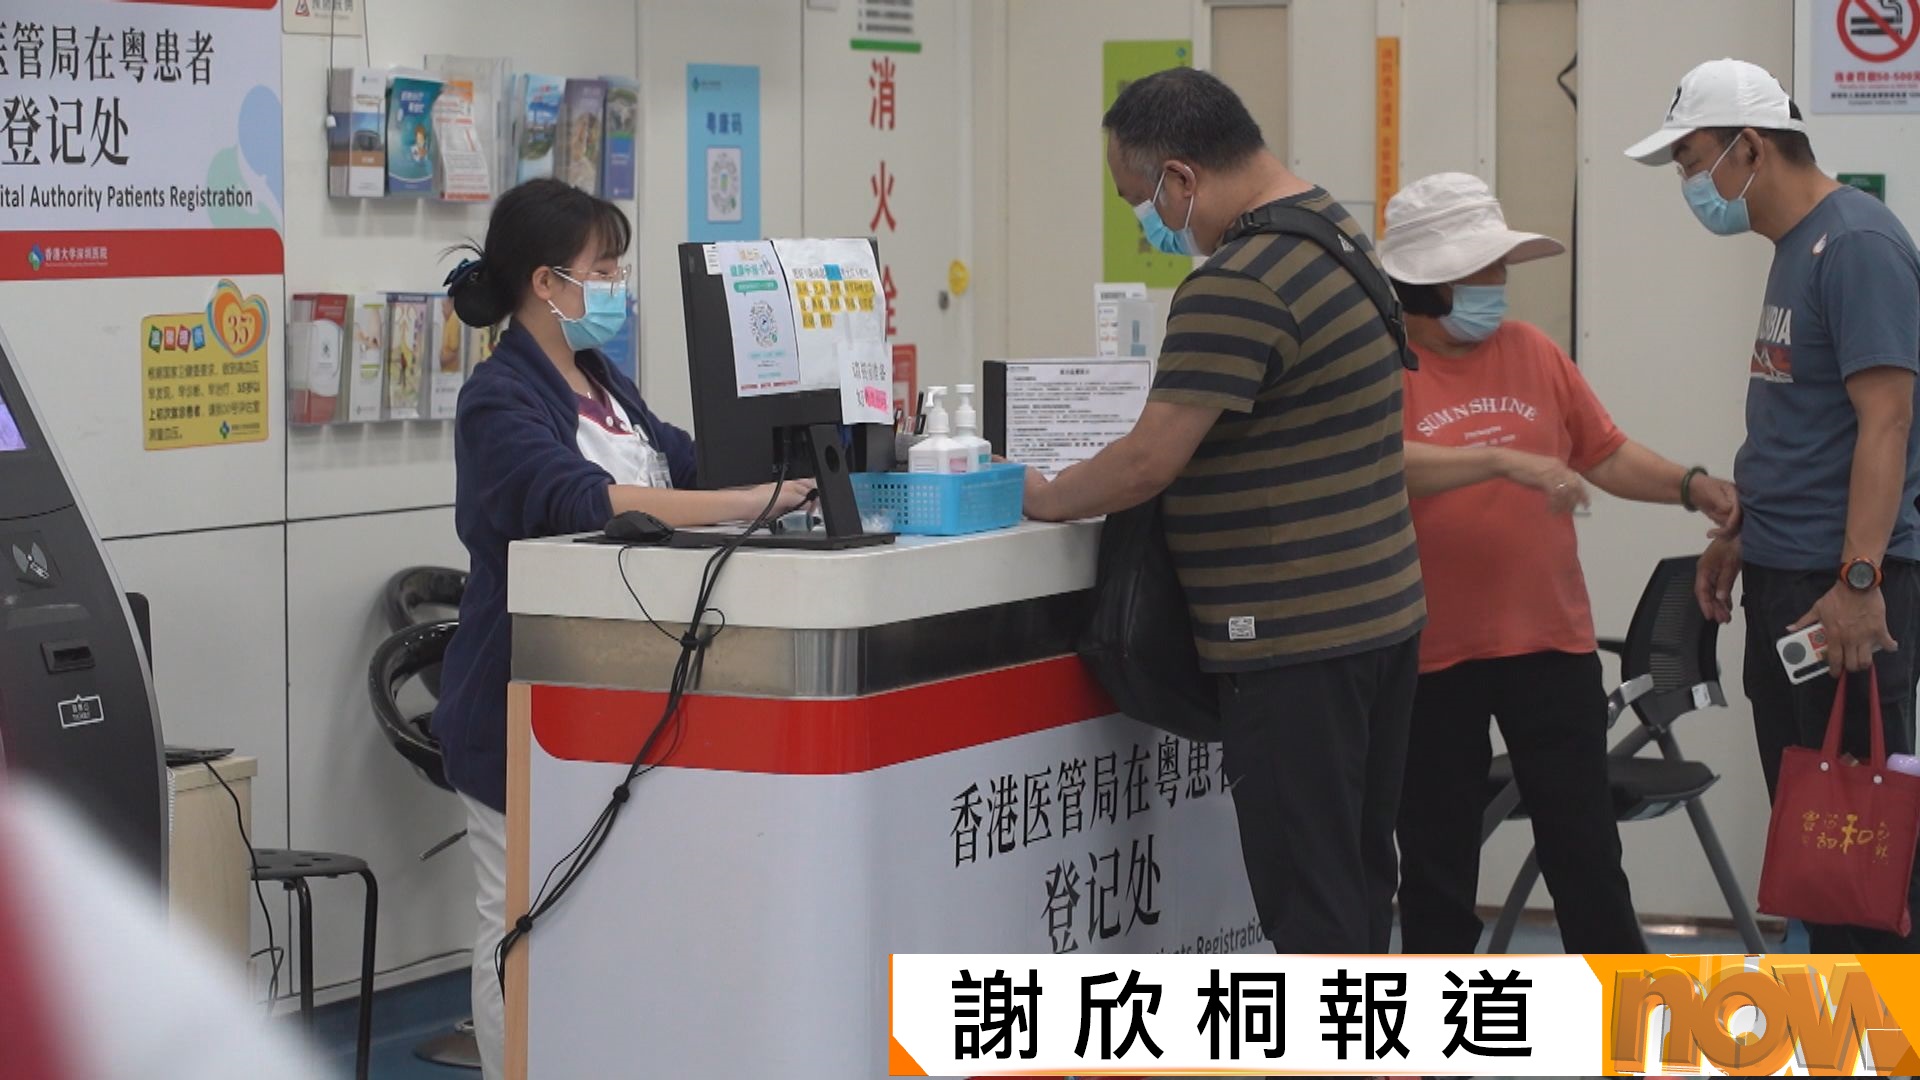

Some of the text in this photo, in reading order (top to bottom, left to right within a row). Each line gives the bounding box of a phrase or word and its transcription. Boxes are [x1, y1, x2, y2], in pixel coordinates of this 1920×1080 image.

[0, 20, 214, 86] 管局在粤患者
[0, 94, 130, 168] 登记处
[29, 184, 102, 213] Authority
[107, 185, 166, 208] Patients
[170, 185, 253, 212] Registration
[1417, 396, 1538, 437] SUMNSHINE
[1040, 833, 1161, 954] 登记处
[1196, 916, 1263, 954] Registratio
